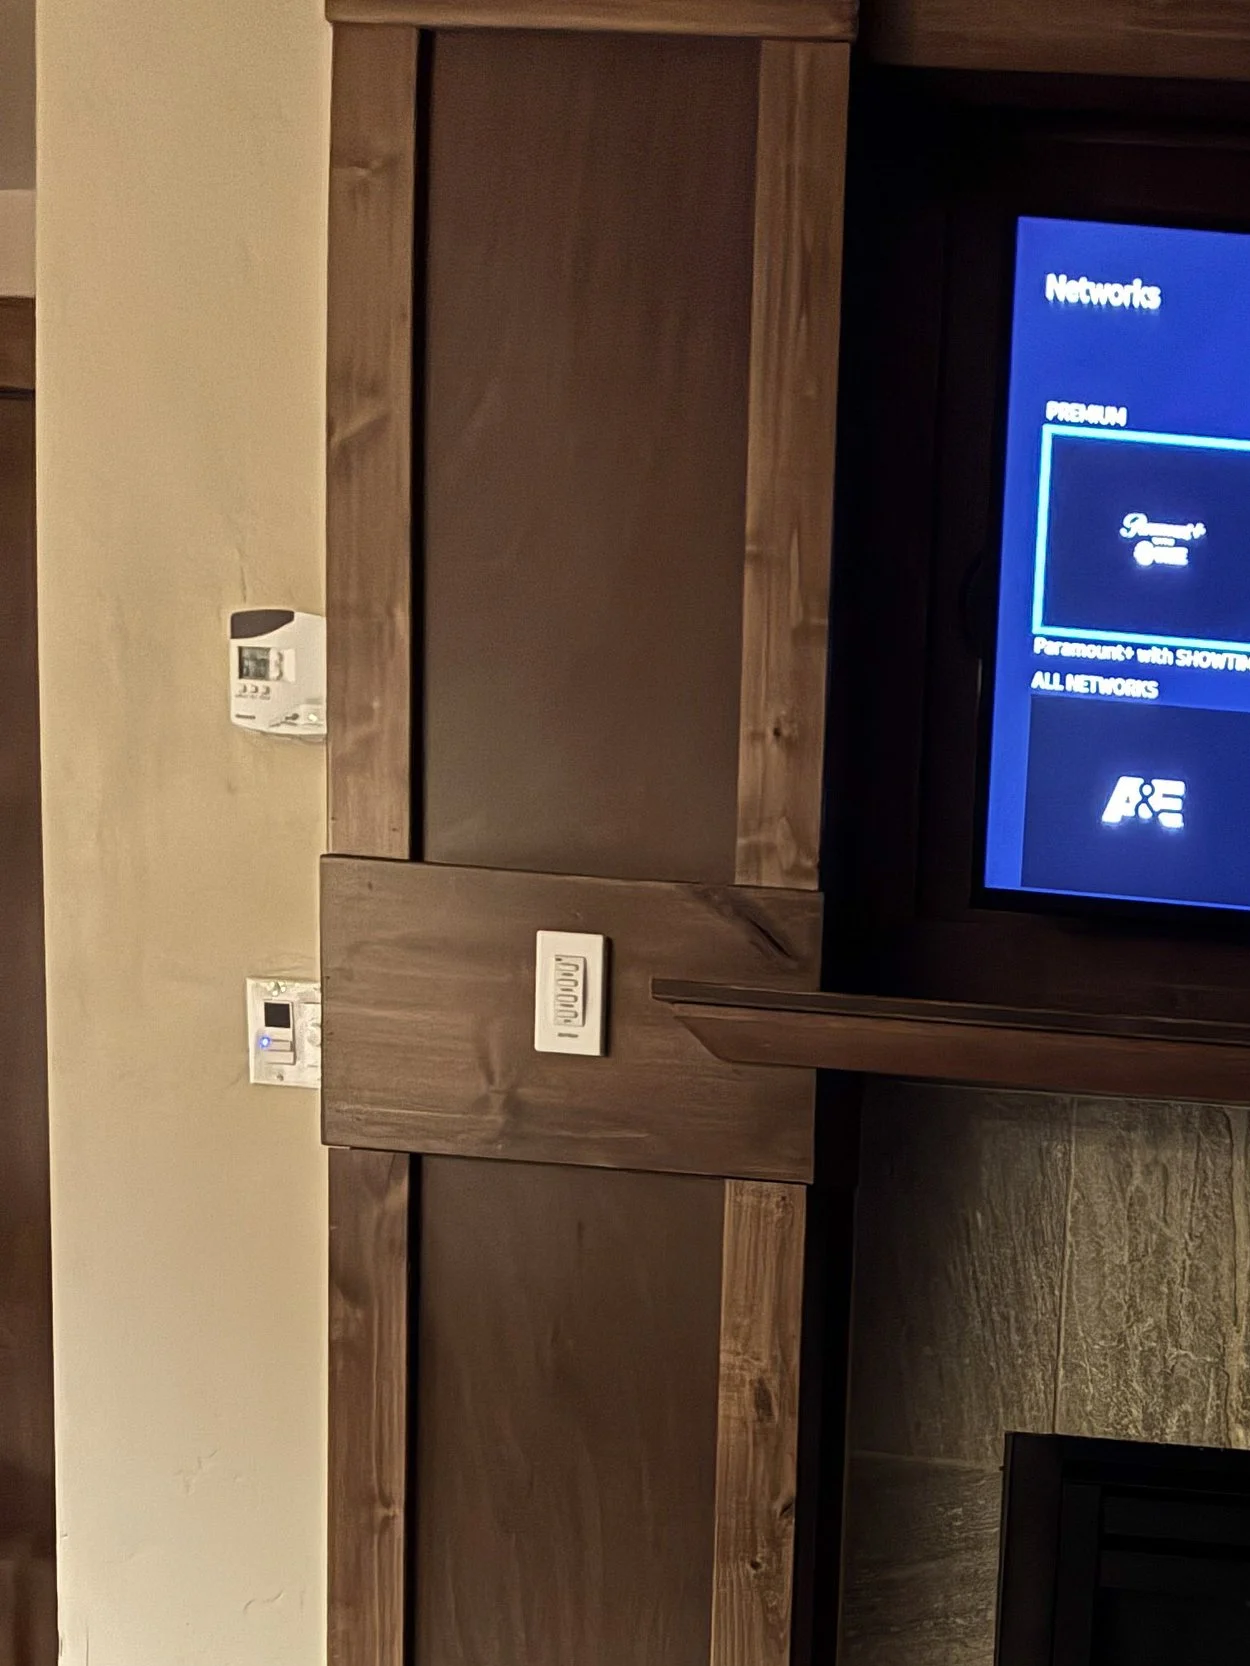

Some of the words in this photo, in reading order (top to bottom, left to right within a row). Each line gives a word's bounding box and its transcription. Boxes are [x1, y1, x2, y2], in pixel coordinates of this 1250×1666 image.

[1045, 272, 1162, 310] Networks
[1045, 400, 1128, 427] PREMIUM
[1033, 636, 1135, 662] Paramount+
[1136, 645, 1174, 666] with
[1030, 670, 1065, 692] ALL
[1065, 673, 1160, 700] NETWORKS
[1101, 775, 1187, 830] A&E
